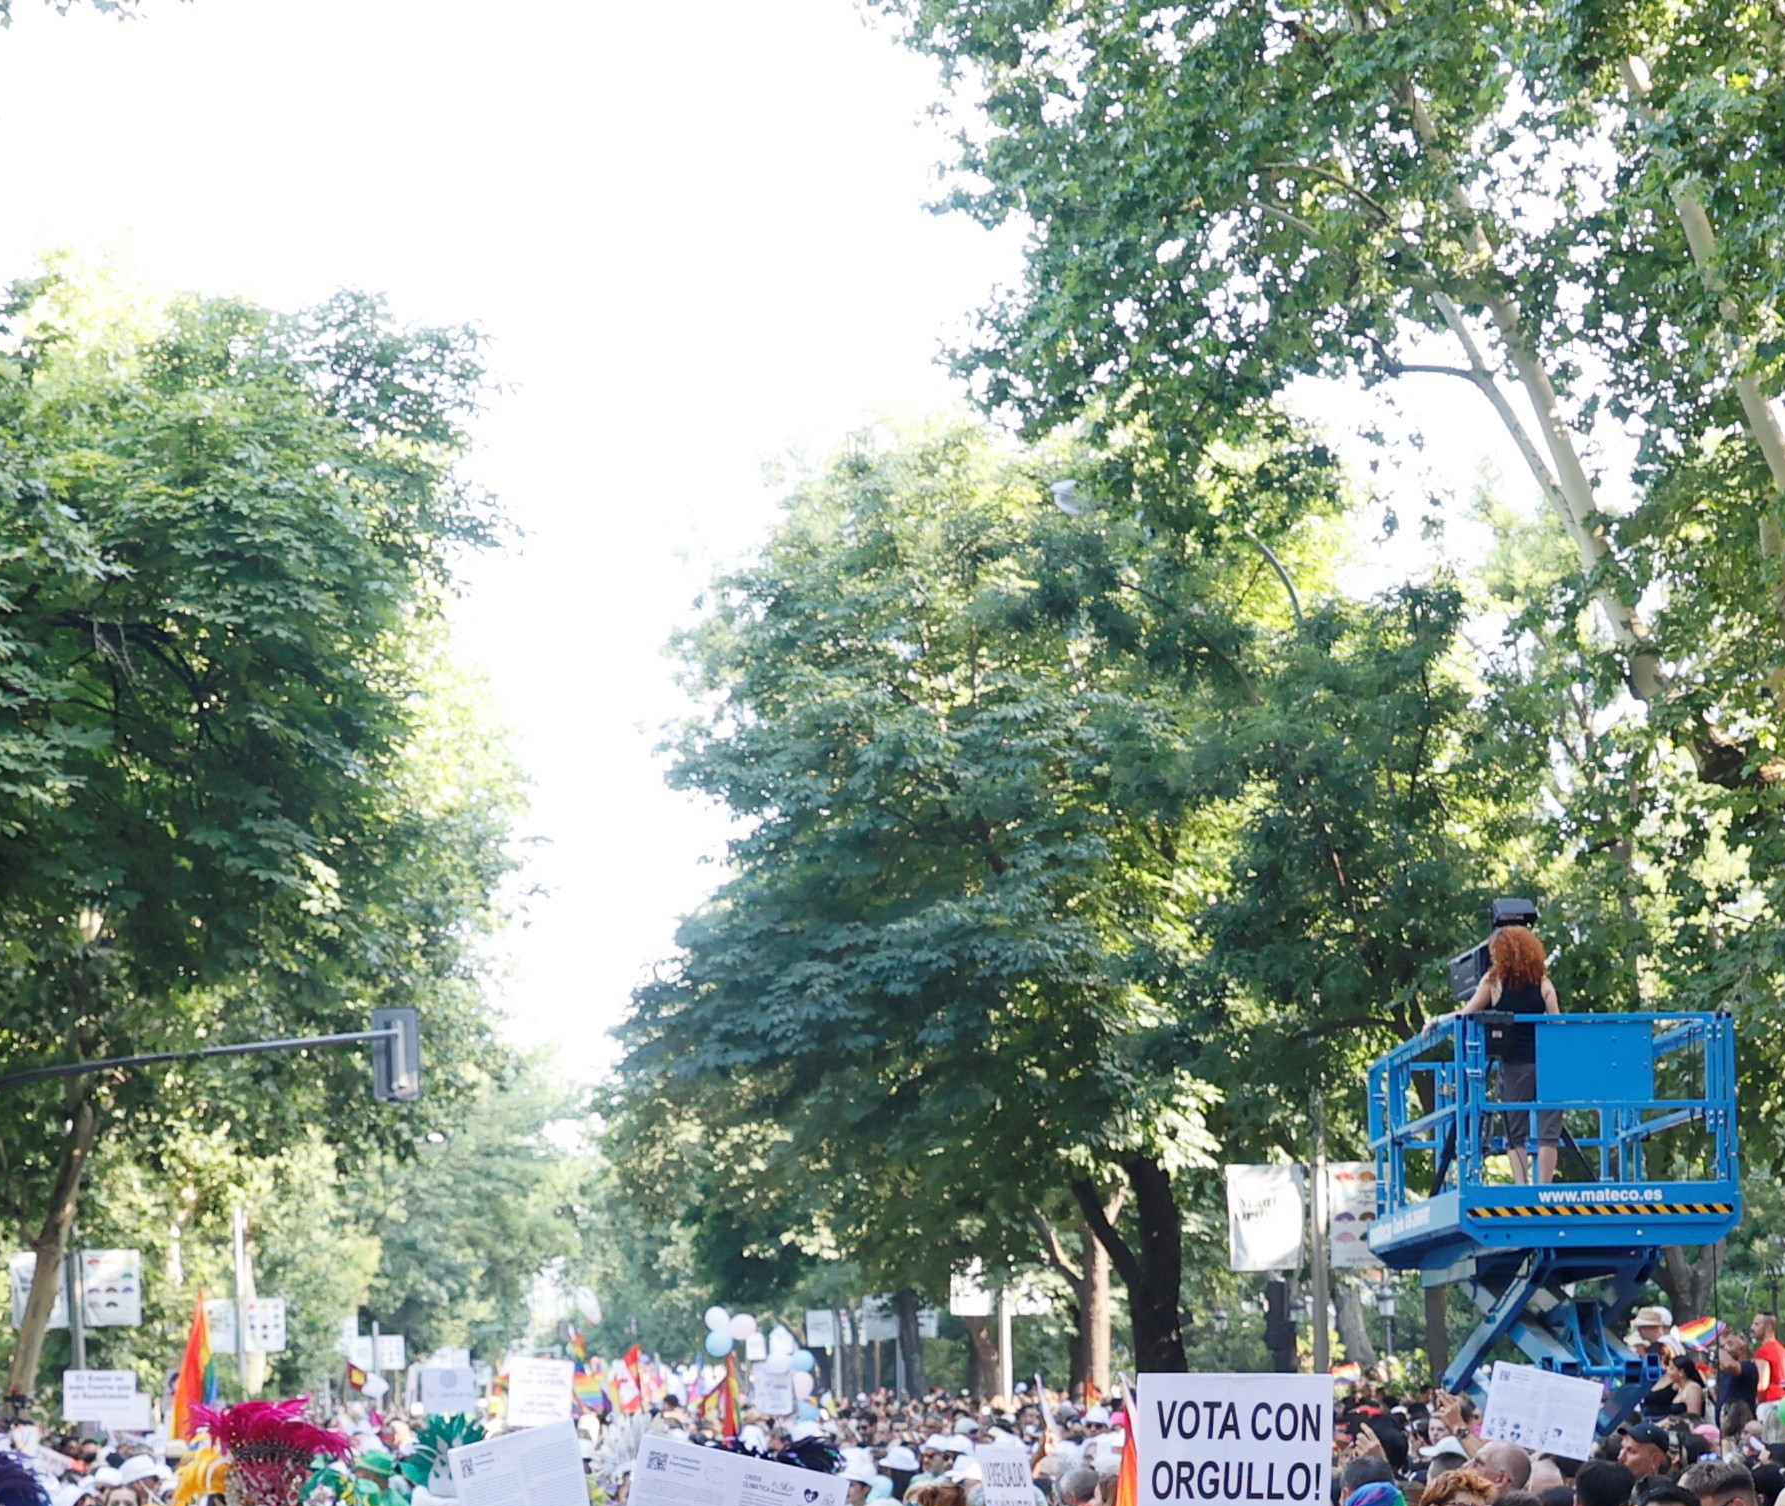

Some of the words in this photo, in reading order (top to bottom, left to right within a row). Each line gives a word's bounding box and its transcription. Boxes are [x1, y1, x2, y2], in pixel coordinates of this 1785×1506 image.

[1538, 1188, 1663, 1203] www.mateco.es
[1157, 1400, 1241, 1441] VOTA
[1251, 1402, 1321, 1442] CON
[1152, 1460, 1322, 1501] ORGULLO!
